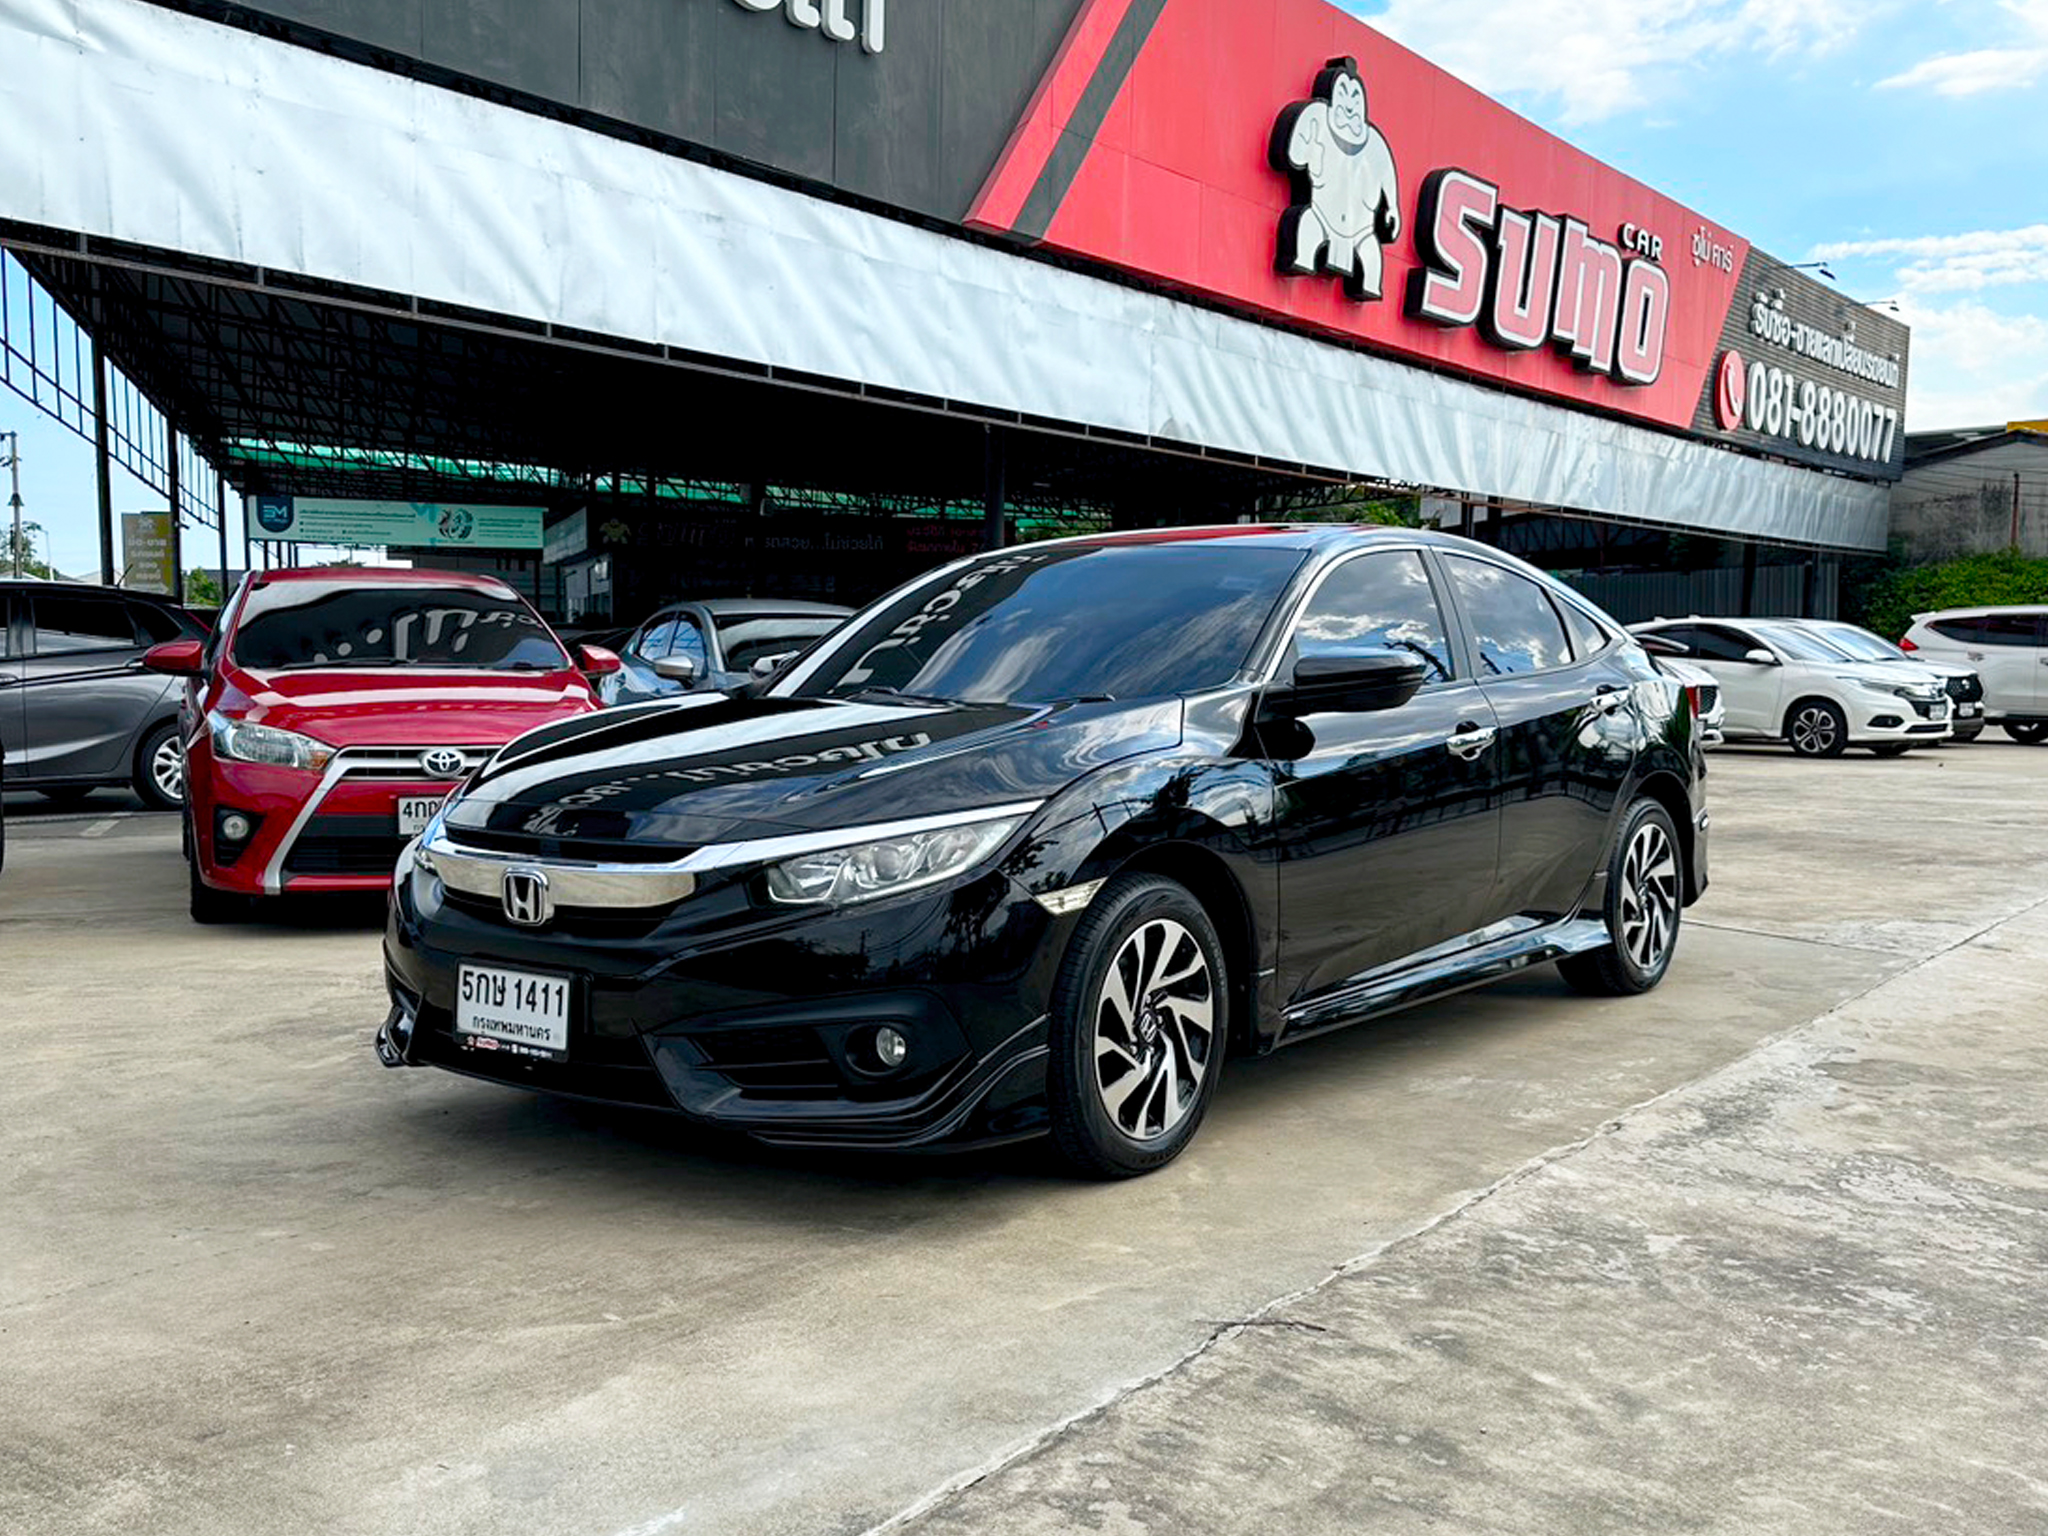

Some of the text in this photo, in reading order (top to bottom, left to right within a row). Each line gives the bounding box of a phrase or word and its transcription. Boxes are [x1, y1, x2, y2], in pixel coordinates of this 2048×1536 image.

[1618, 222, 1664, 262] CAR
[1747, 361, 1898, 464] 081-8880077
[462, 970, 564, 1017] 5กษ 1411
